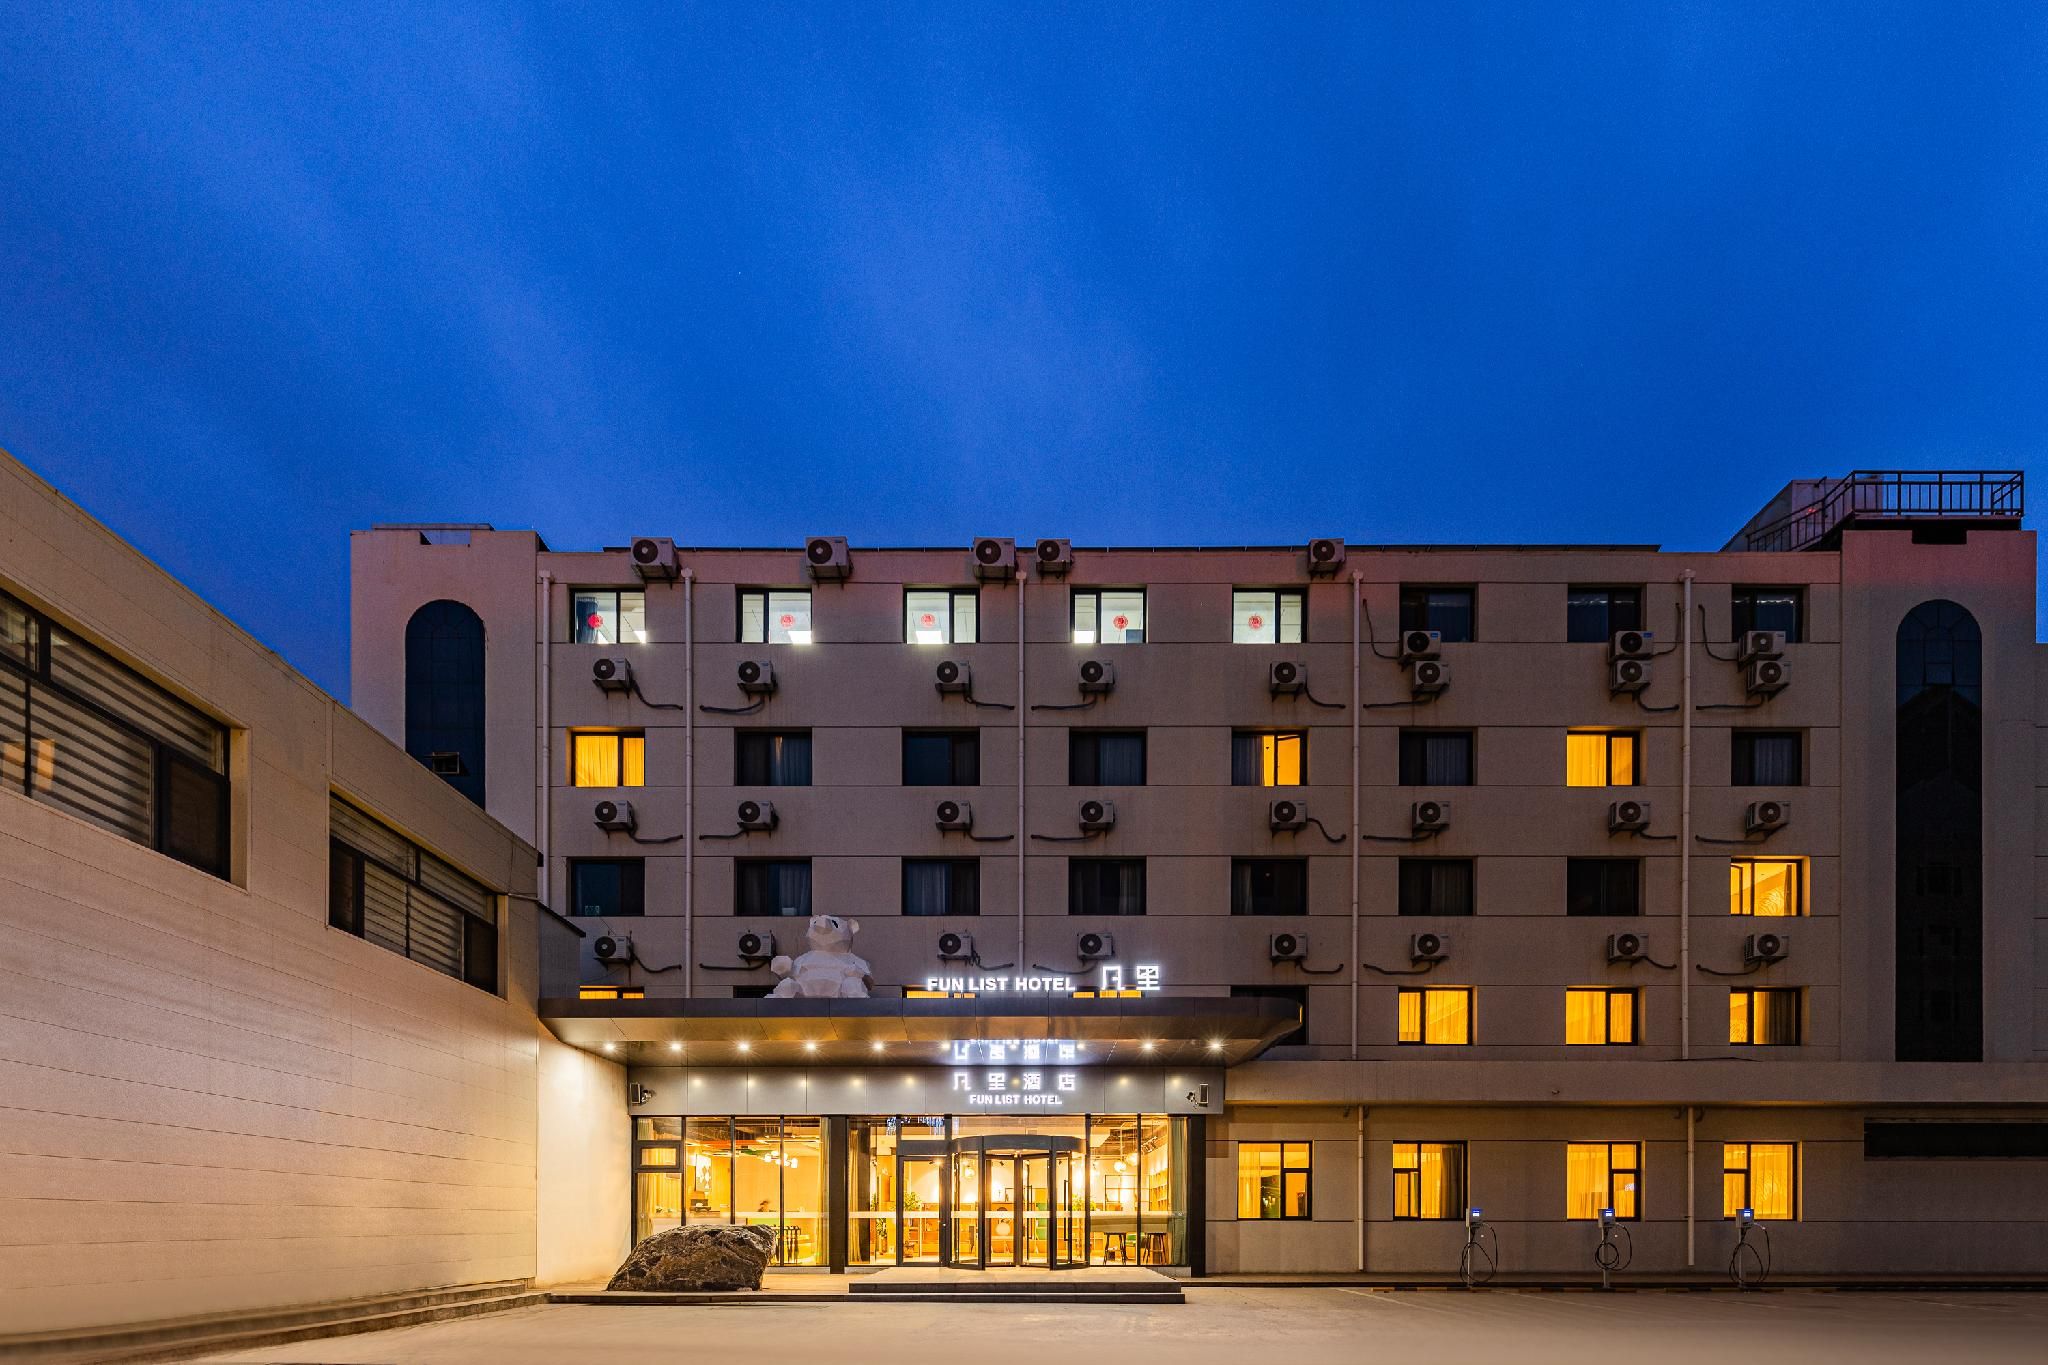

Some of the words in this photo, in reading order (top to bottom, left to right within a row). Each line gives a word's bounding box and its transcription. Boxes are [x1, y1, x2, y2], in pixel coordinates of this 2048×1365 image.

[927, 977, 963, 991] FUN
[969, 977, 1008, 991] LIST
[1015, 977, 1076, 991] HOTEL
[953, 1072, 1076, 1091] 凡里酒店
[969, 1094, 993, 1105] FUN
[995, 1094, 1020, 1105] LIST
[1024, 1094, 1063, 1105] HOTEL
